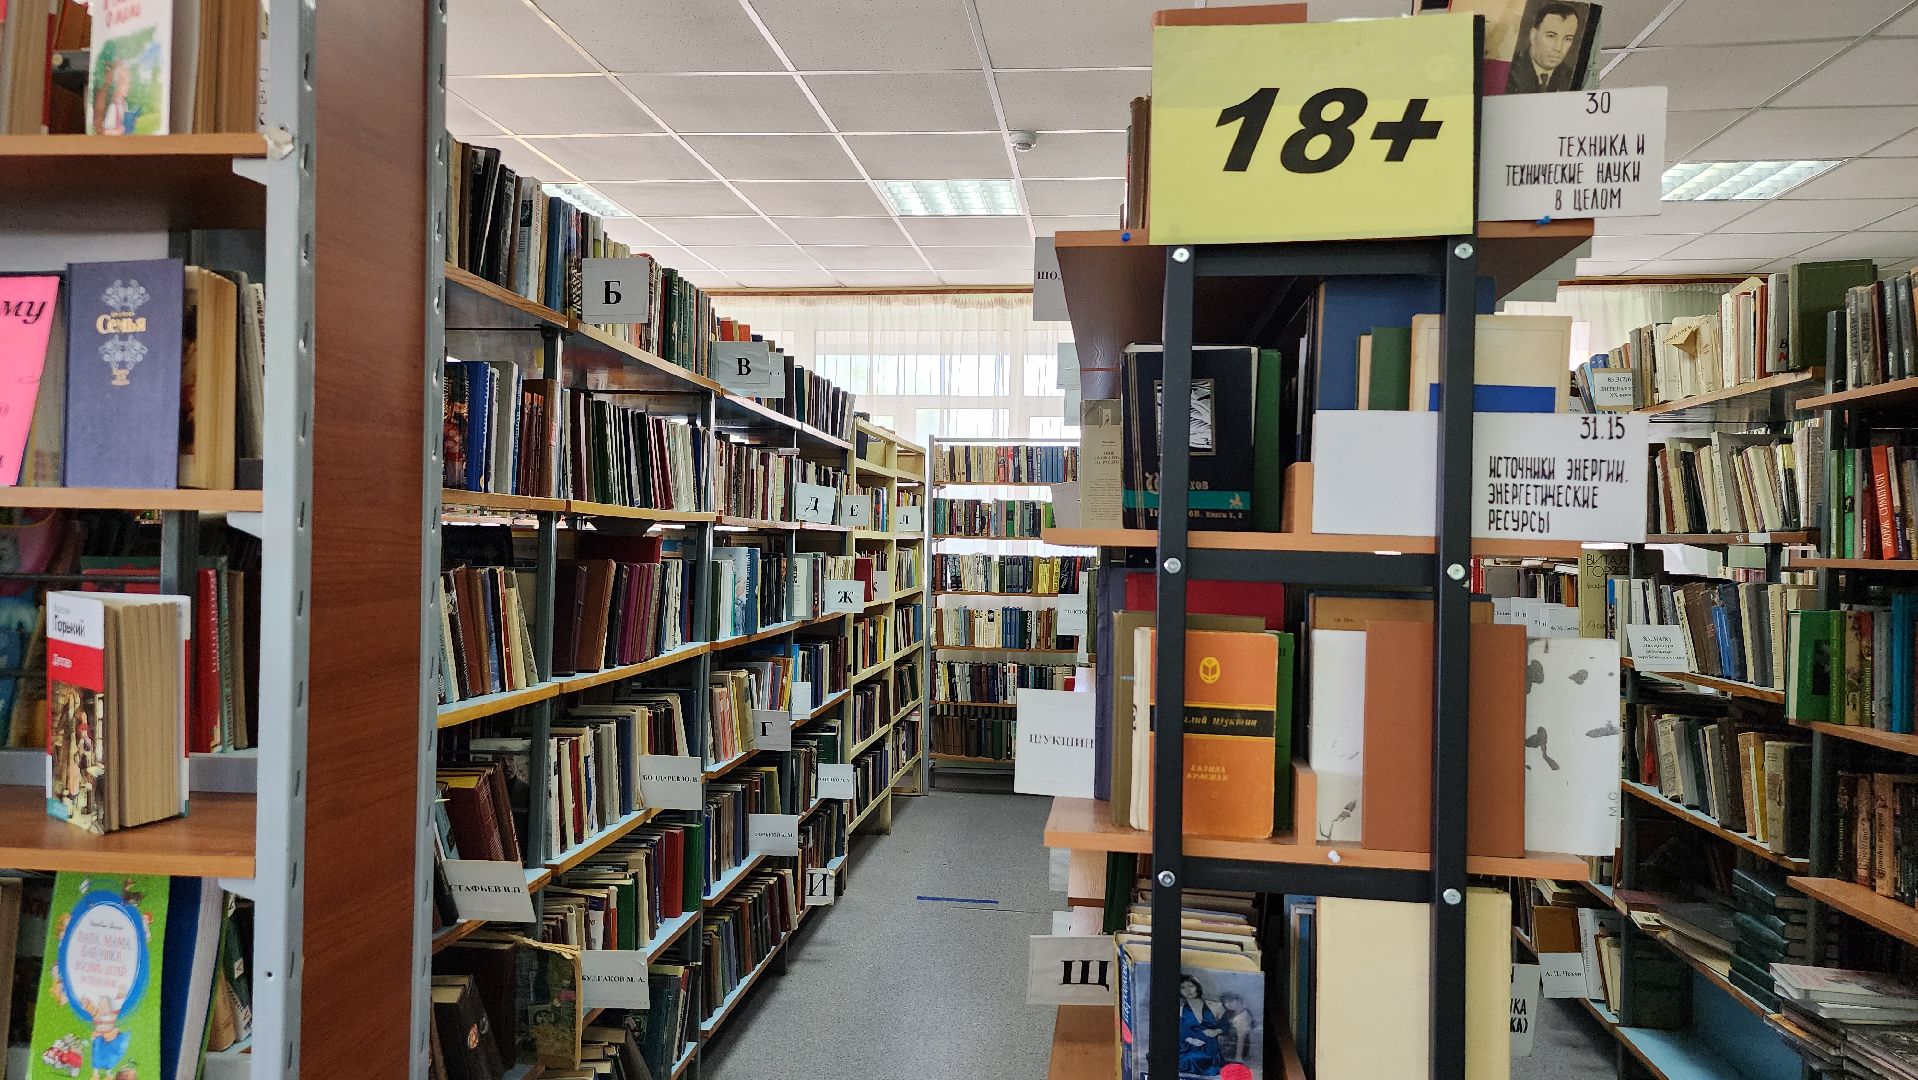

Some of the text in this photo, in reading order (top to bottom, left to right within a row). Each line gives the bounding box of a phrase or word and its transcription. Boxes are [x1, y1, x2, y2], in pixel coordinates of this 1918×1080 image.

[1586, 92, 1611, 114] 30
[1216, 88, 1443, 174] 18+
[1558, 134, 1645, 157] ТЕХНИКА И
[1506, 161, 1640, 186] ТЕХНИЧЕСКИЕ НАУКИ
[1555, 188, 1622, 211] В ЦЕЛОМ
[601, 280, 622, 305] Б
[736, 358, 752, 376] В
[1580, 416, 1625, 440] 31.15
[1489, 456, 1629, 483] ИСТОЧНИКИ ЭНЕРГИИ.
[805, 496, 819, 515] Д
[1488, 483, 1599, 509] ЭНЕРГЕТИЧЕСКИЕ
[849, 504, 859, 517] Е
[900, 515, 910, 525] Л
[1488, 508, 1550, 533] РЕСУРСЫ
[837, 591, 854, 604] Ж
[760, 721, 774, 737] Г
[449, 884, 502, 893] СТАФЬЕВ
[807, 872, 829, 897] И
[1060, 959, 1112, 992] Щ
